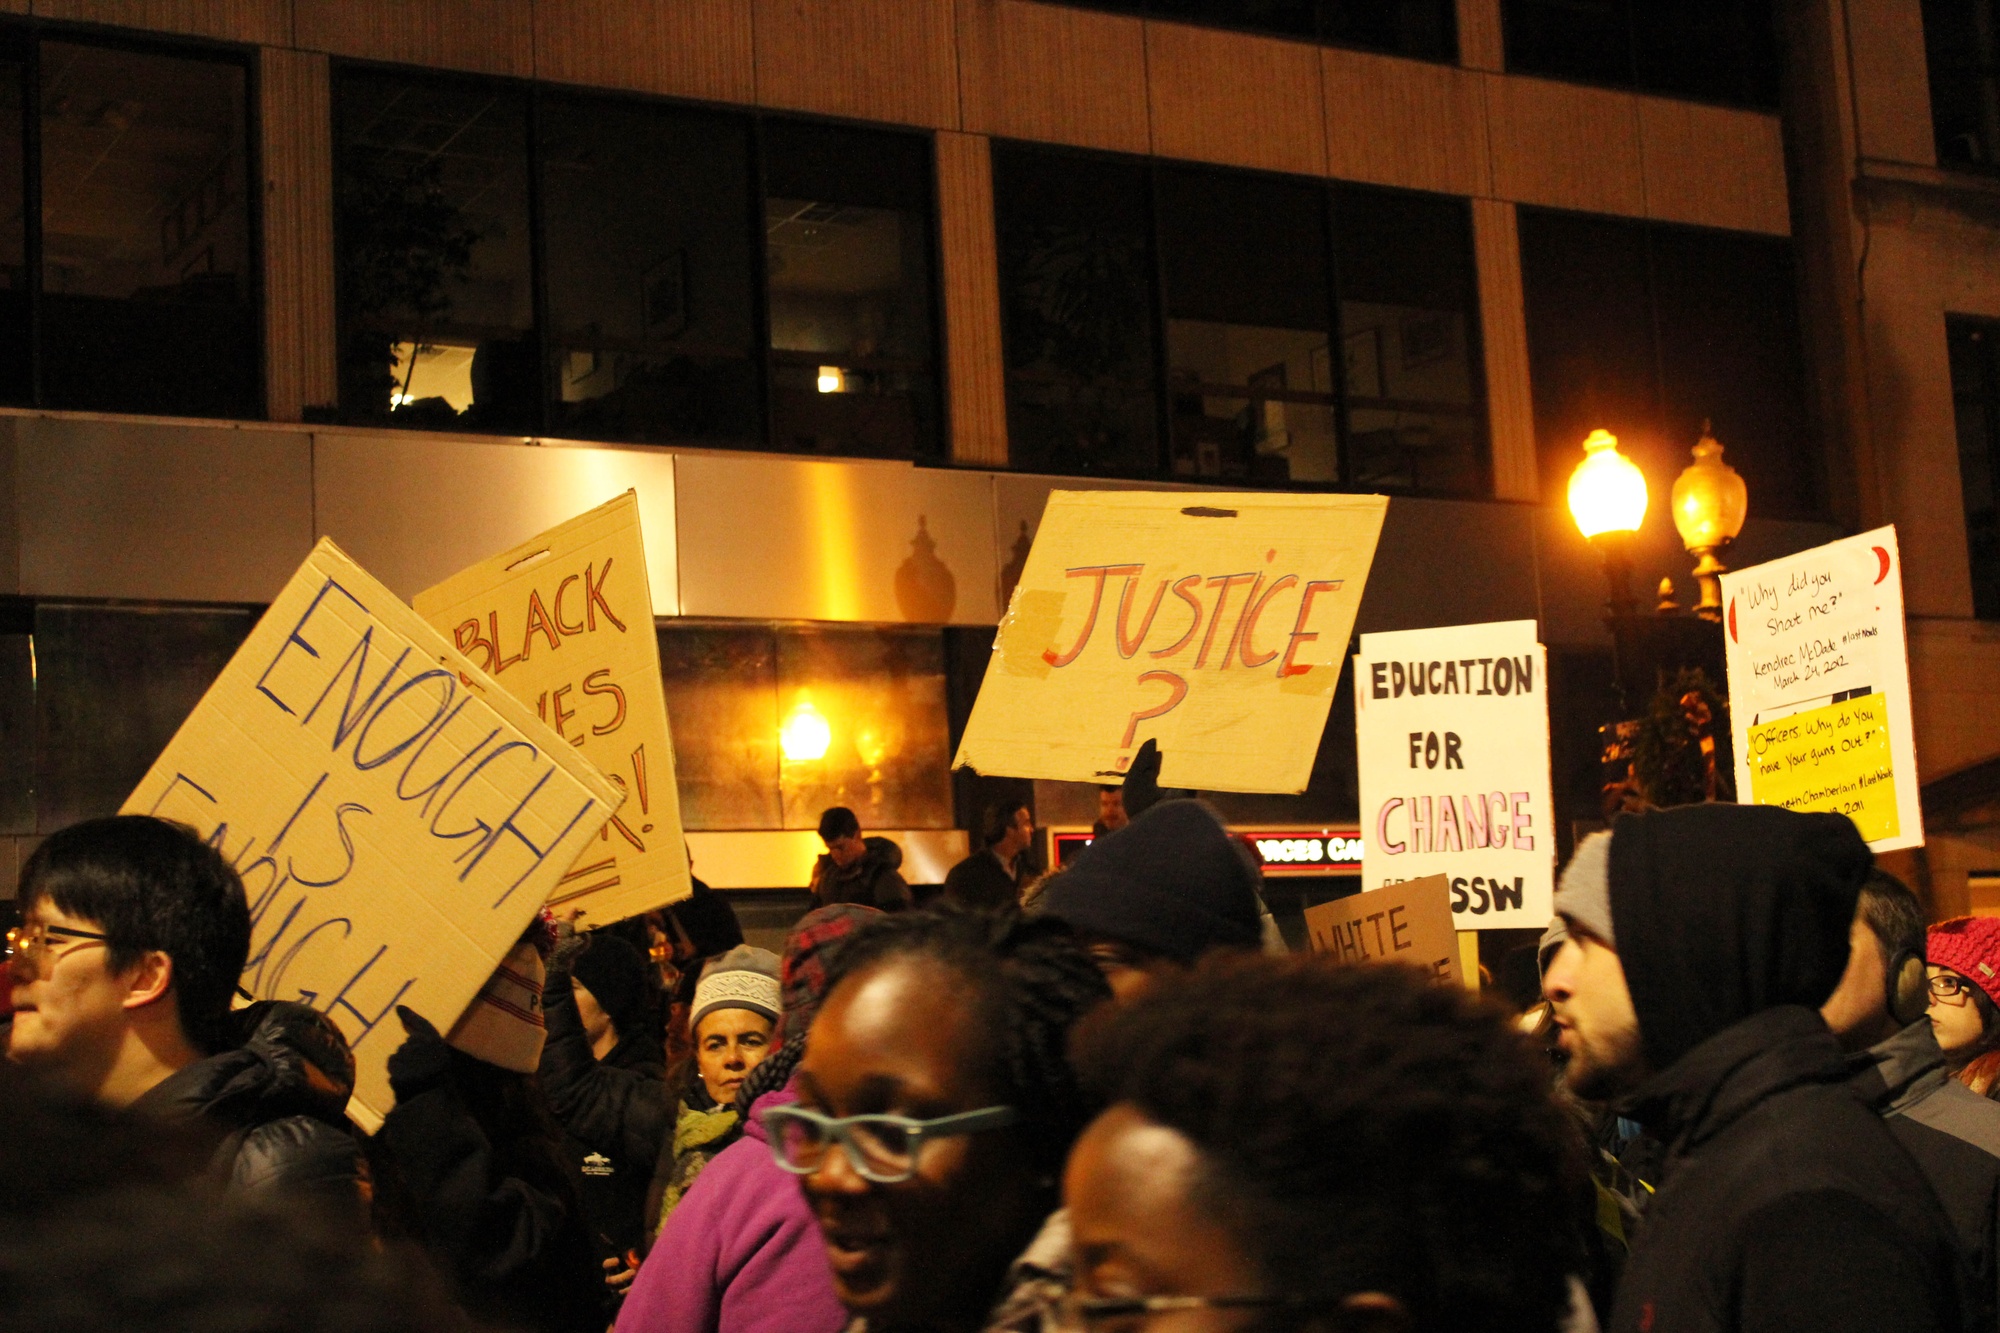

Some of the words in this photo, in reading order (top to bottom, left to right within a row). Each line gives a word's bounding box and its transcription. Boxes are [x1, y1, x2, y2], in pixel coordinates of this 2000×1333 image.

[1788, 571, 1808, 596] did
[1812, 572, 1831, 597] you
[454, 558, 626, 685] BLACK
[1041, 548, 1345, 678] JUSTICE
[1370, 655, 1533, 699] EDUCATION
[1773, 671, 1800, 690] March
[1824, 655, 1849, 675] 2012
[256, 576, 595, 909] ENOUGH
[1116, 670, 1188, 771] ?
[1806, 717, 1833, 738] Why
[1837, 713, 1850, 728] do
[1854, 708, 1874, 721] You
[1409, 731, 1464, 770] FOR
[1811, 745, 1836, 766] guns
[1377, 791, 1535, 855] CHANGE
[1845, 800, 1865, 815] 2011
[266, 773, 373, 887] IS
